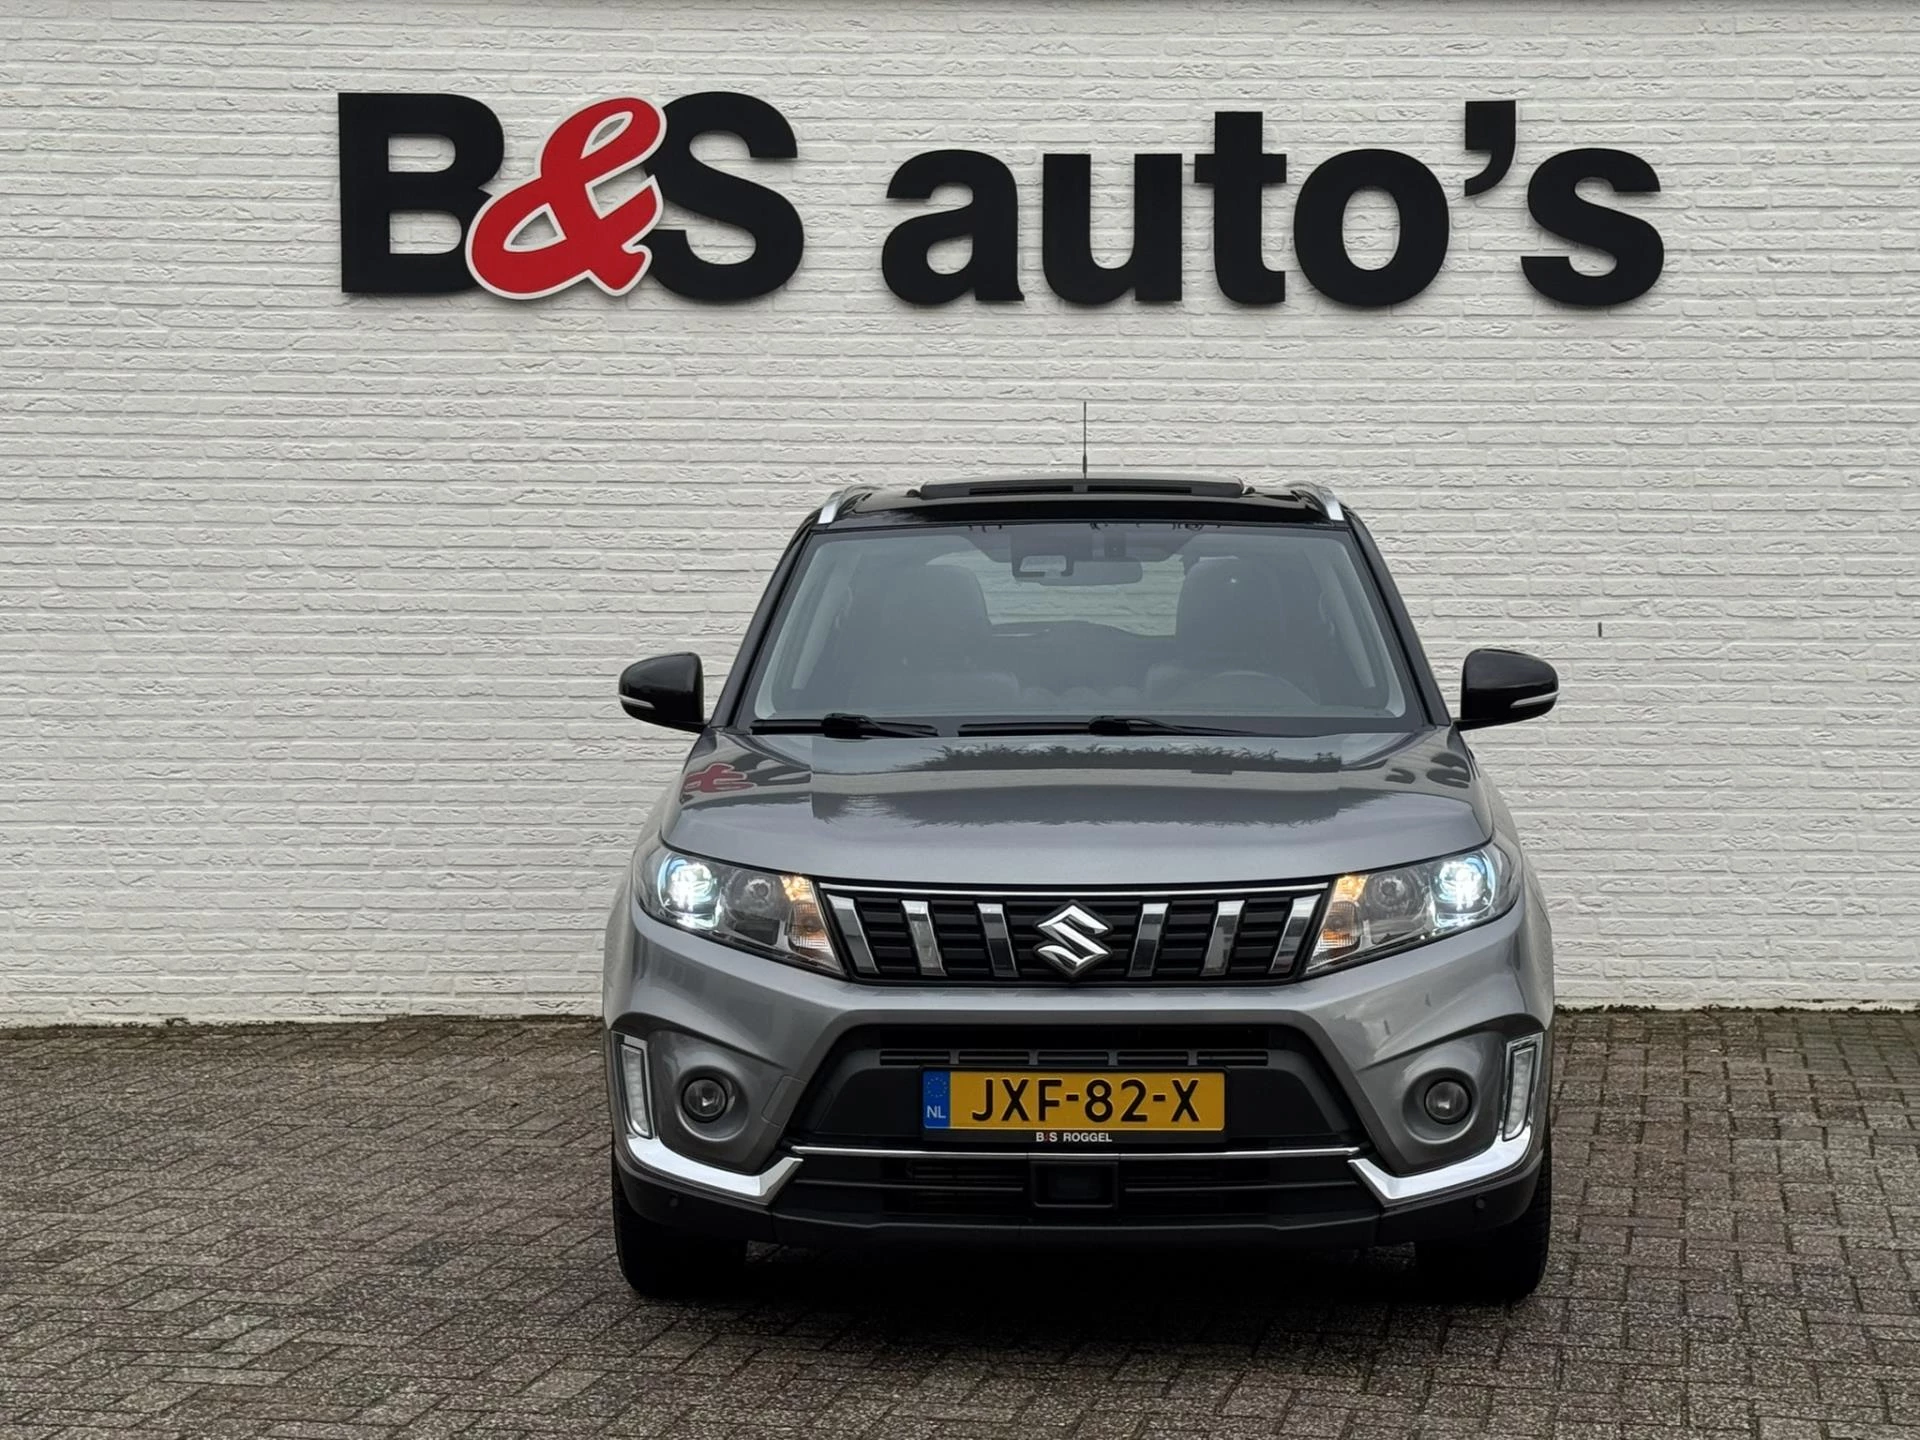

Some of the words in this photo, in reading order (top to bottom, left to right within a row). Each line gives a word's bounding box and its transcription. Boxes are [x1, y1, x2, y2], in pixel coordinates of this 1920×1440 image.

[338, 91, 803, 300] B&S
[881, 100, 1665, 307] auto's
[926, 1105, 946, 1119] NL
[972, 1078, 1200, 1122] JXF-82-X
[1063, 1132, 1112, 1142] ROGGEL
